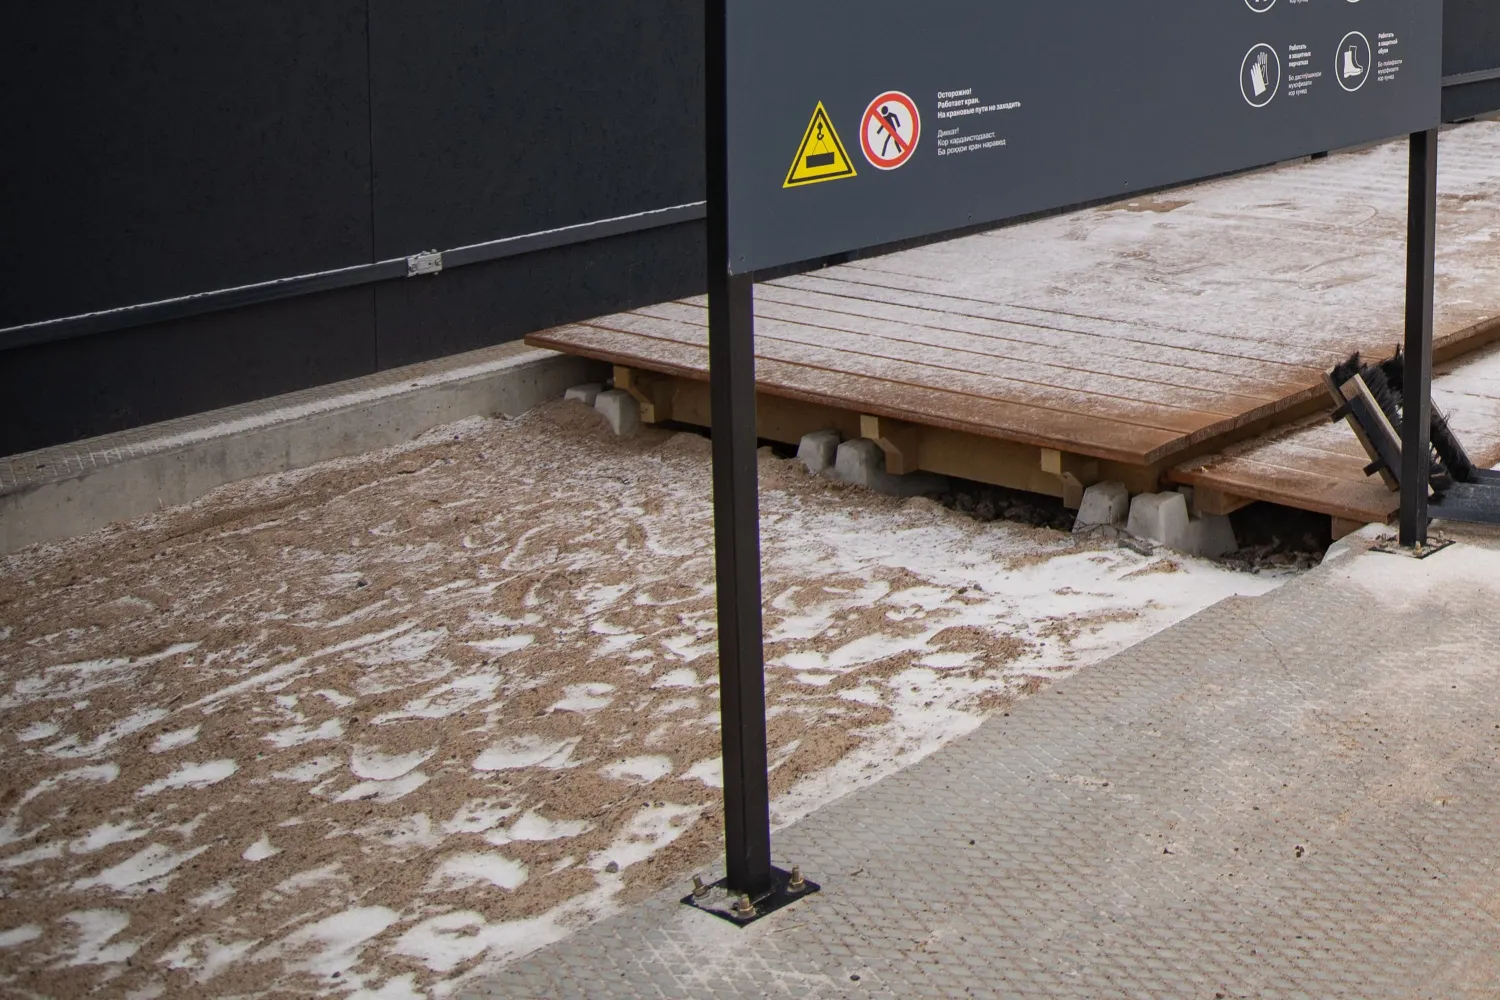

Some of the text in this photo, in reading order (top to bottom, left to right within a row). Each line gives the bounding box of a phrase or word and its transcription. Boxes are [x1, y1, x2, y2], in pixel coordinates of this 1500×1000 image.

[937, 88, 972, 99] Осторожно!
[937, 99, 964, 109] Работает
[937, 111, 946, 119] На
[946, 107, 975, 118] крановые
[975, 106, 988, 115] пути
[996, 101, 1021, 110] заходить
[937, 138, 948, 147] Кор
[937, 148, 945, 156] Ба
[968, 143, 981, 151] кран
